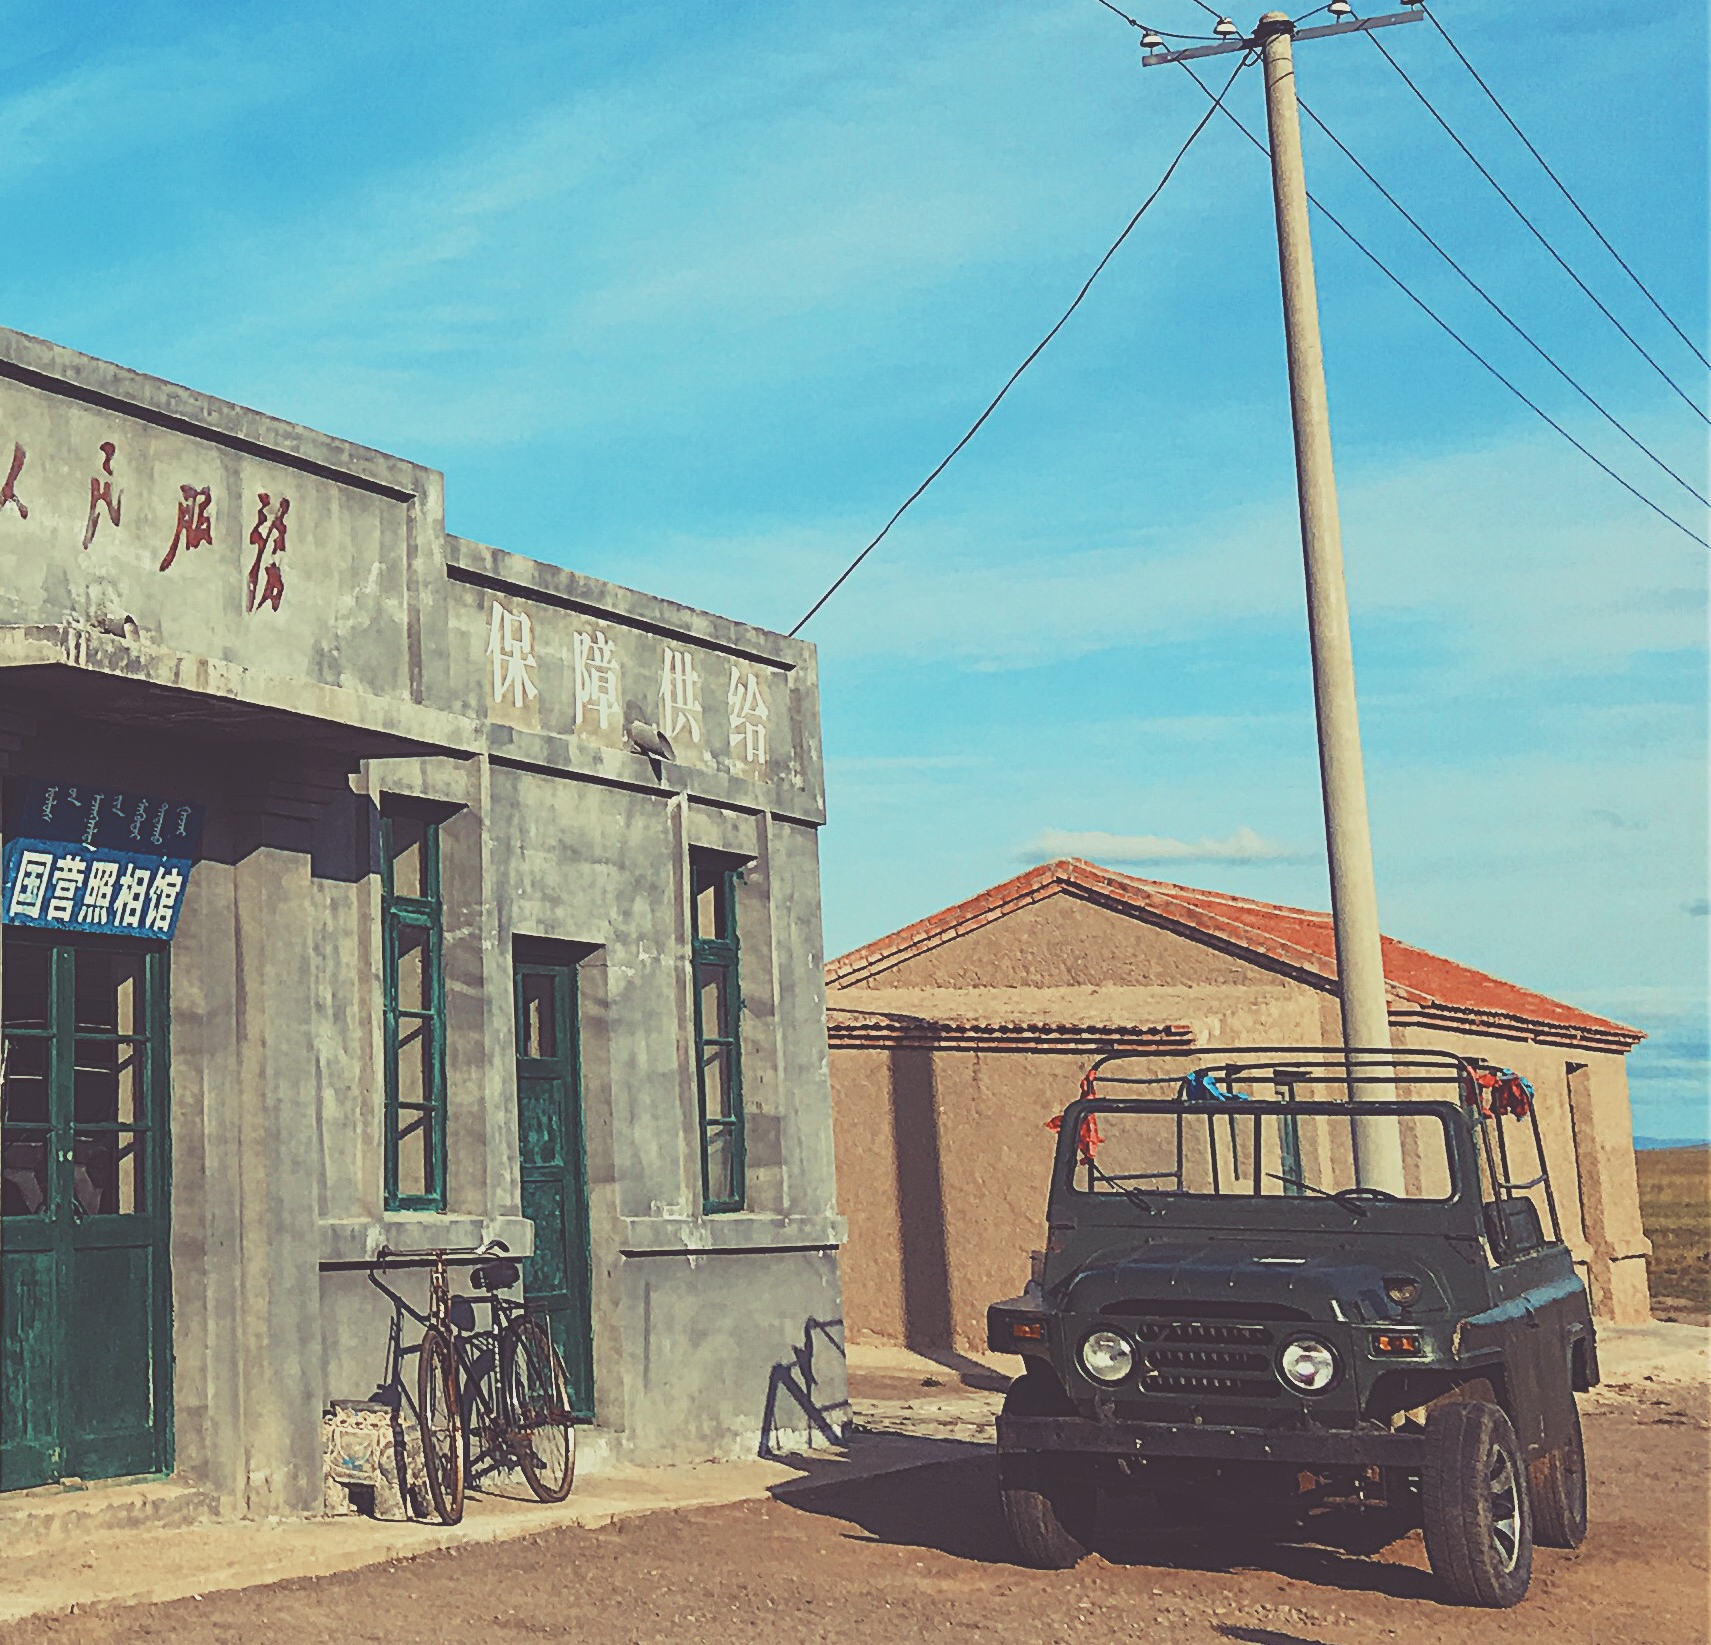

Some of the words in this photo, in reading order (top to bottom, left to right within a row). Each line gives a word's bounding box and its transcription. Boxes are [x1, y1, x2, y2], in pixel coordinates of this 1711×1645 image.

[486, 600, 768, 764] 保障供给
[8, 850, 183, 933] 国营照相馆
